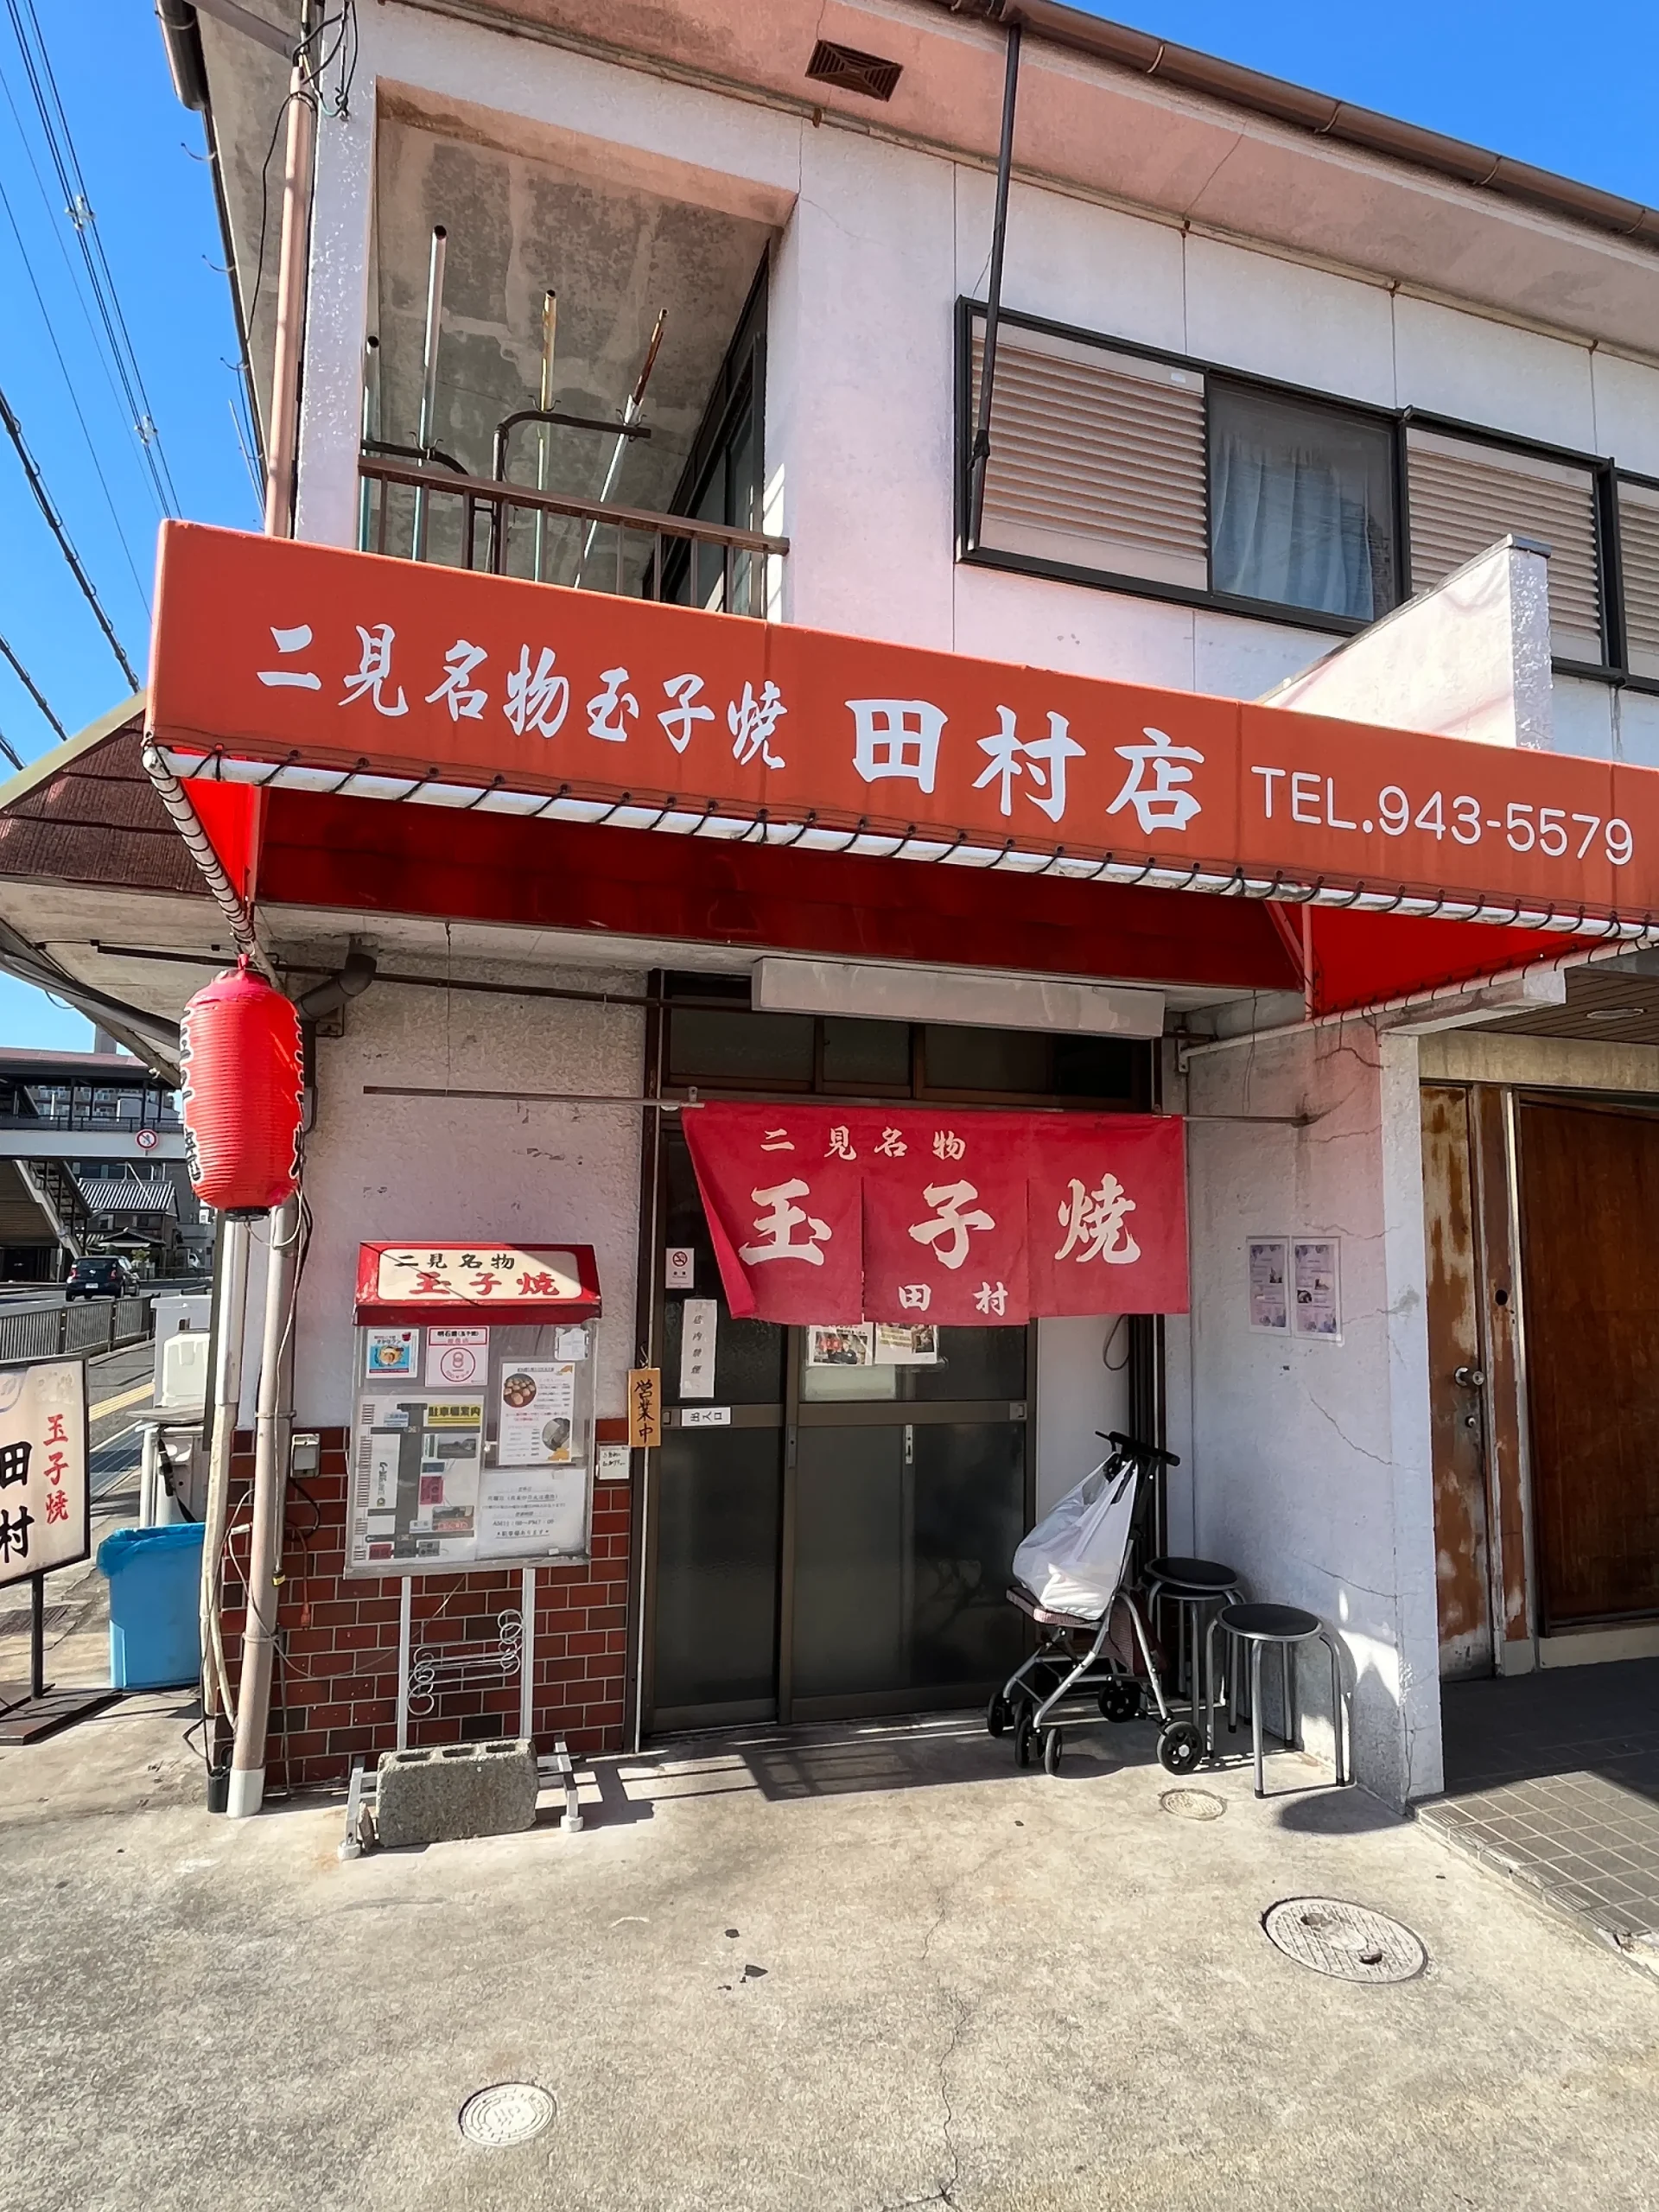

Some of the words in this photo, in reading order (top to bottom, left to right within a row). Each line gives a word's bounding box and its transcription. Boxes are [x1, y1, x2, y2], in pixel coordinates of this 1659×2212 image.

[257, 623, 787, 769] 二見名物玉子焼
[844, 698, 1205, 836] 田村店
[1251, 765, 1634, 865] TEL.943-5579
[760, 1126, 966, 1160] 二見名物
[739, 1173, 1141, 1268] 玉子焼
[394, 1253, 516, 1270] 二見名物
[409, 1271, 560, 1297] 玉子焼
[899, 1281, 1009, 1316] 田村
[633, 1377, 655, 1445] 営業中
[690, 1411, 723, 1422] 出入口
[0, 1440, 35, 1564] 田村
[43, 1413, 70, 1525] 玉子焼
